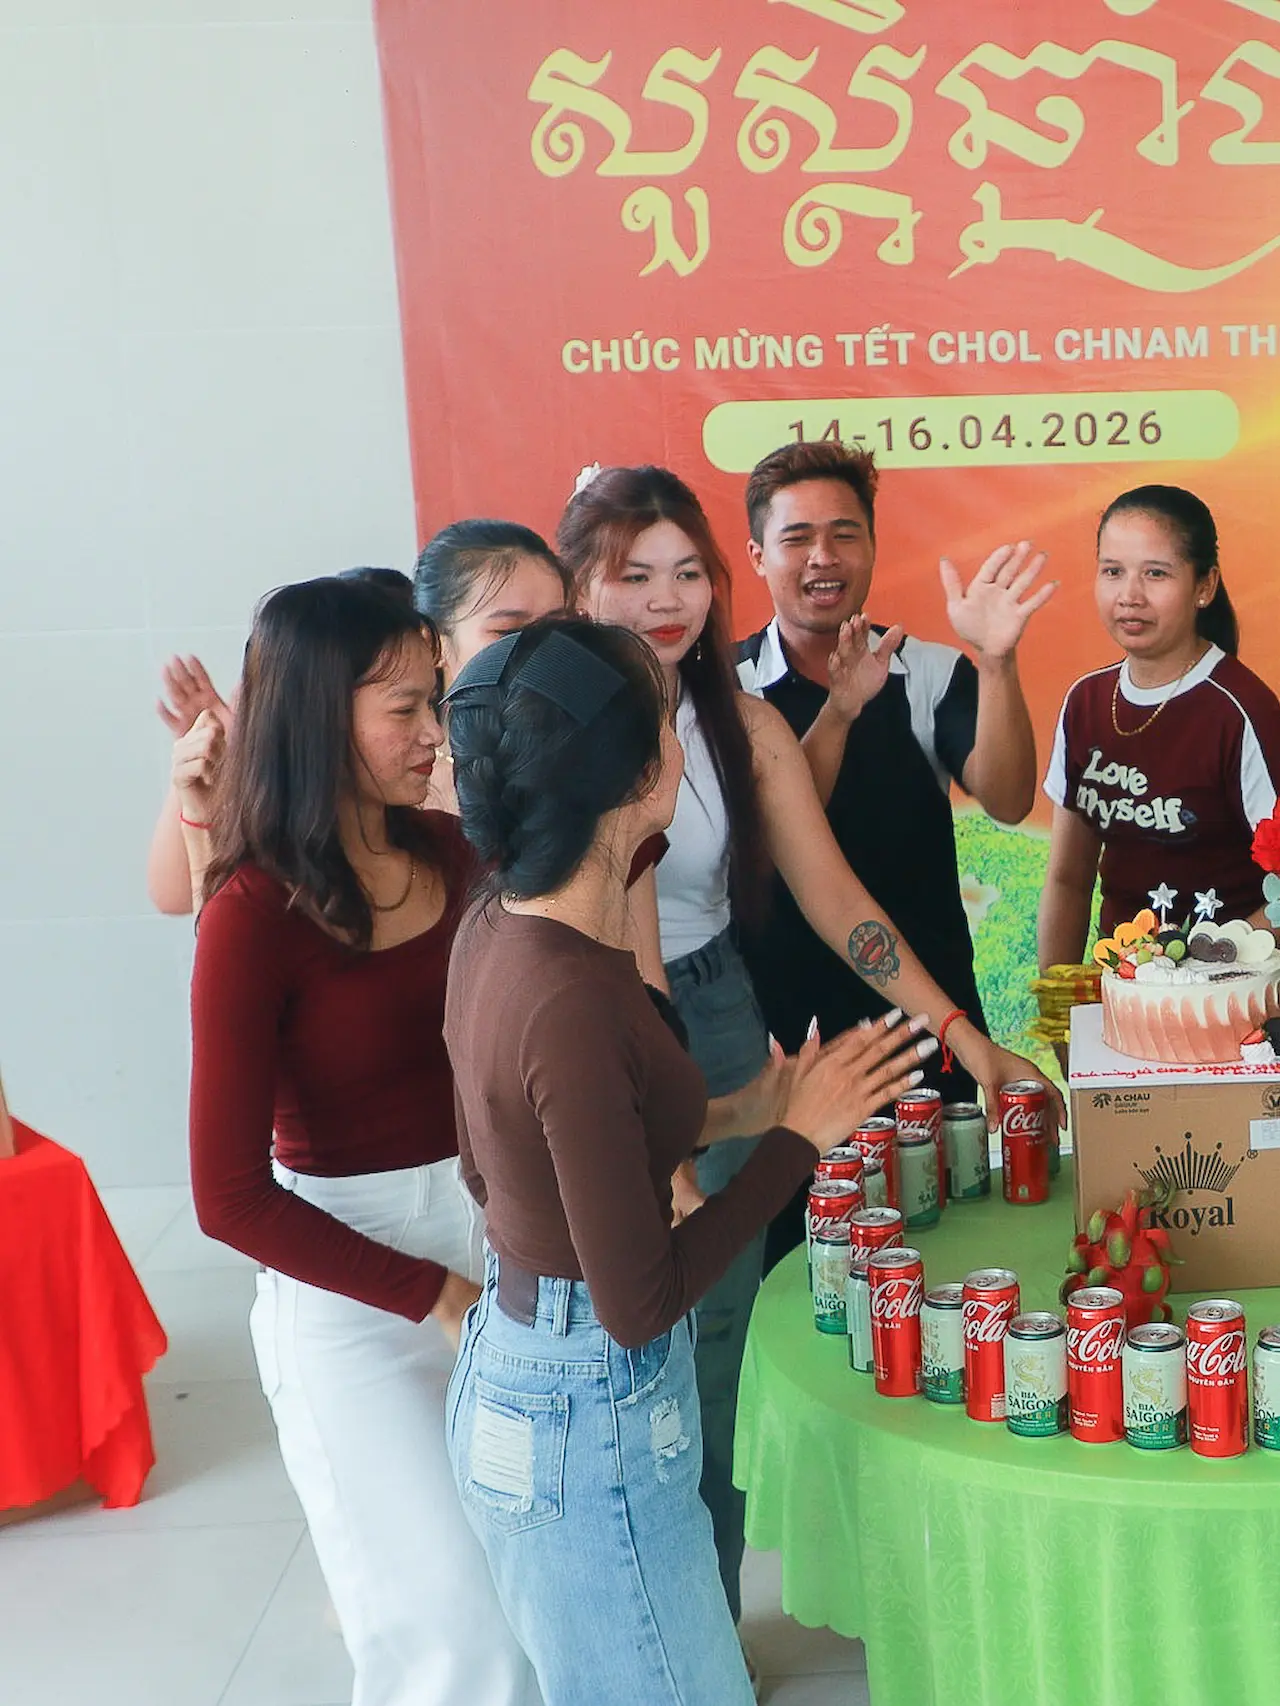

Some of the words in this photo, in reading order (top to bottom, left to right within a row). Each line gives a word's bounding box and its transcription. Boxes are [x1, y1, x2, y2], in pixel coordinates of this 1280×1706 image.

[561, 330, 681, 374] CHÚC
[694, 327, 824, 370] MỪNG
[836, 323, 916, 367] TẾT
[928, 329, 1042, 365] CHOL
[1054, 326, 1209, 362] CHNAM
[1082, 749, 1148, 796] Love
[1076, 784, 1186, 833] myself
[1148, 1197, 1236, 1236] Royal
[1008, 1395, 1057, 1411] SAIGON
[1126, 1406, 1175, 1423] SAIGON
[1138, 1403, 1156, 1411] BIA
